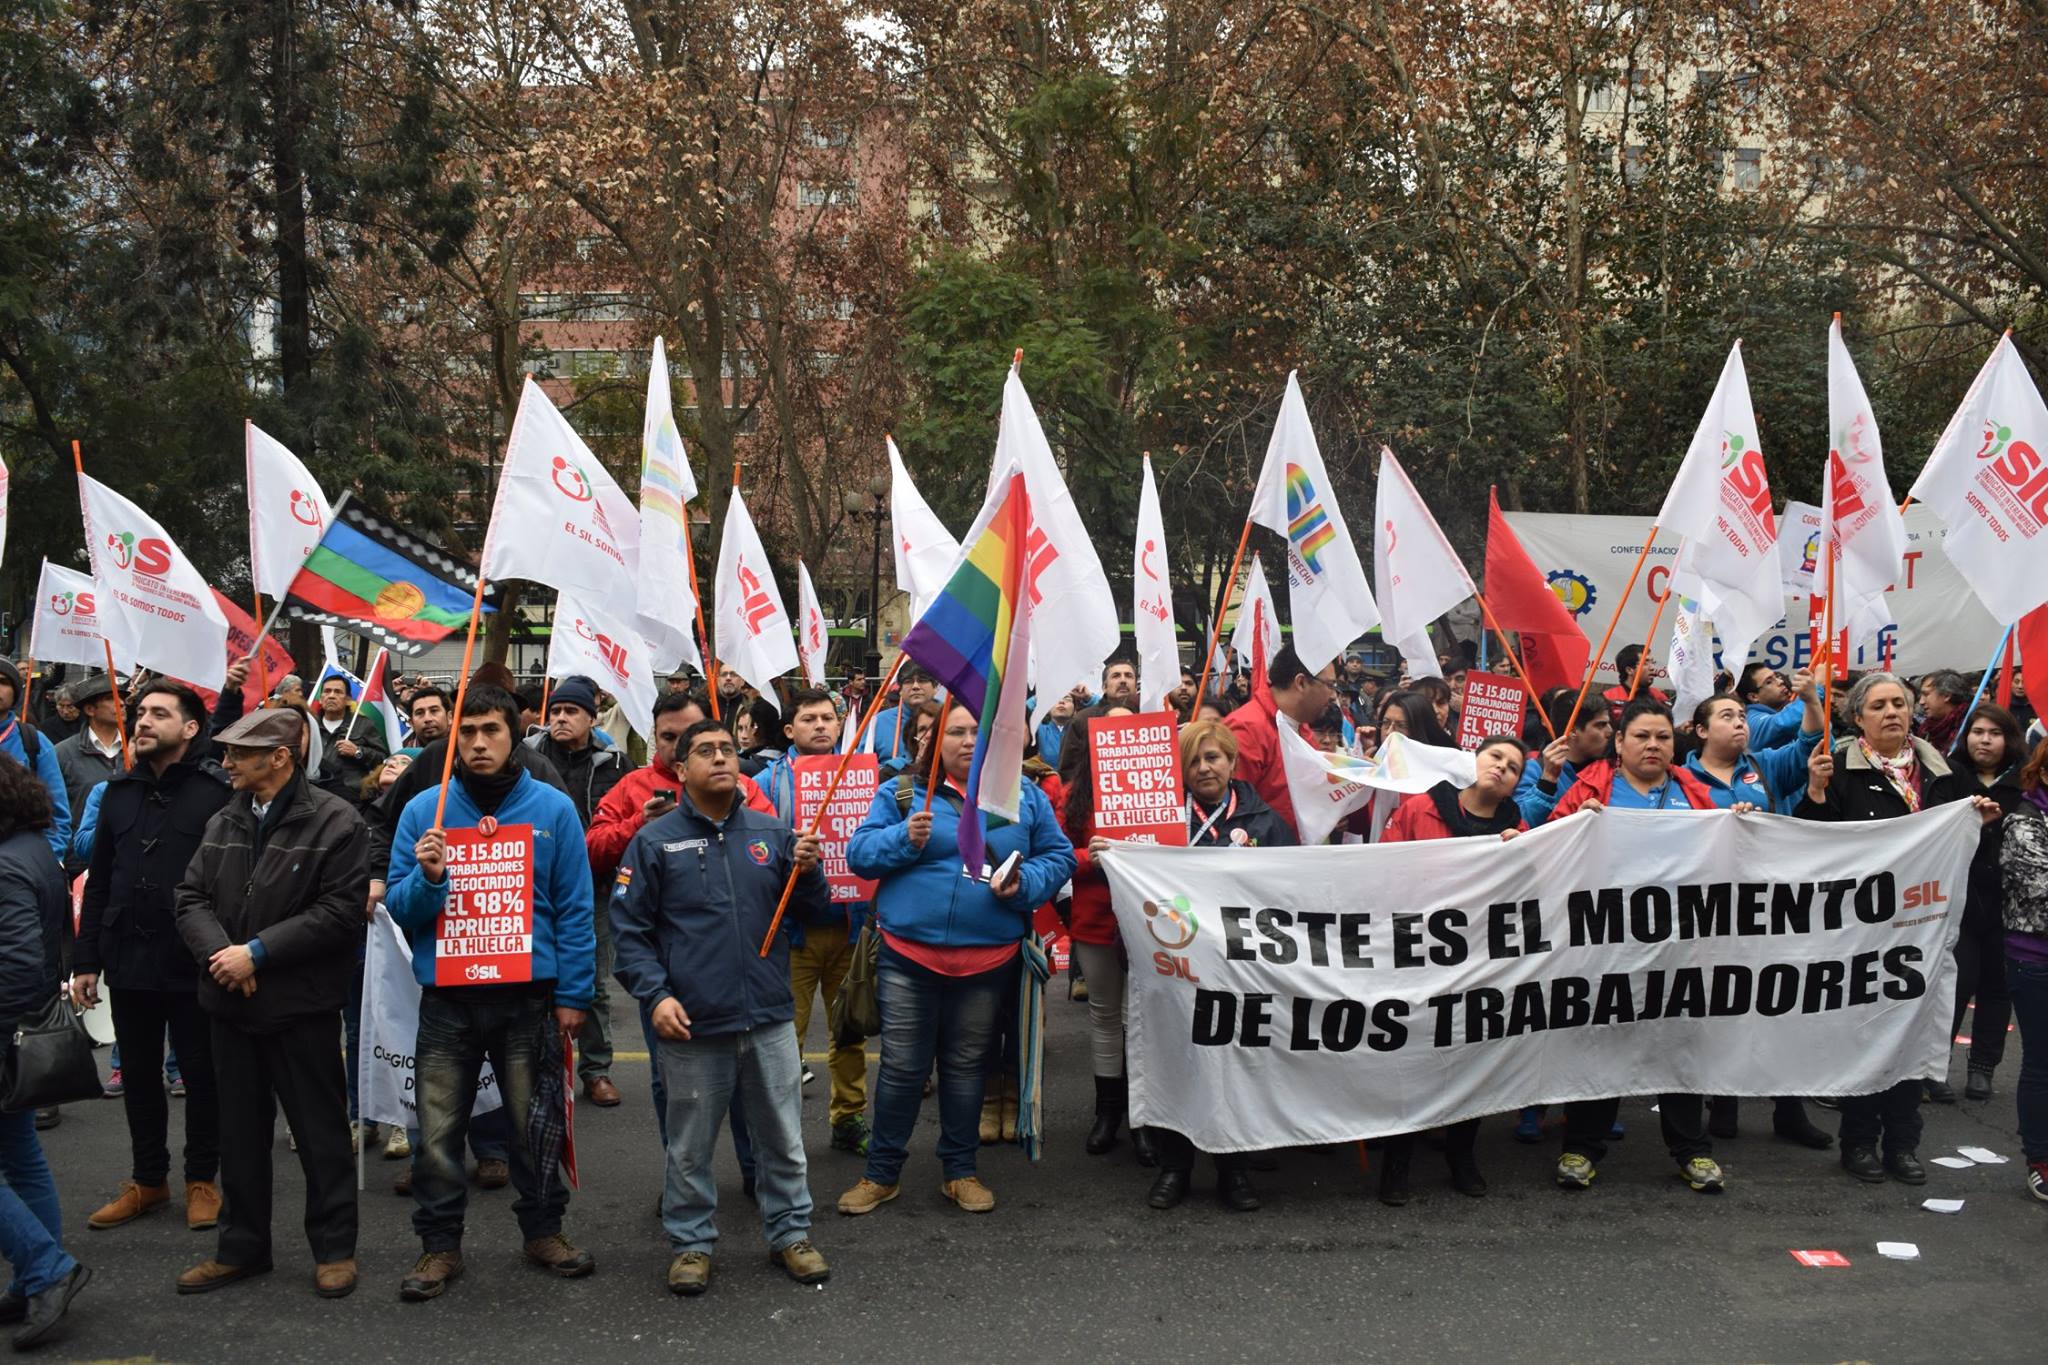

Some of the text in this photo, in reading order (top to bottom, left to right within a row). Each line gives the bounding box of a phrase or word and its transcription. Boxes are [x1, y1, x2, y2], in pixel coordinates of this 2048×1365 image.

[1720, 481, 1743, 511] INDICATO
[1965, 491, 1990, 518] SOMOS
[1987, 514, 2010, 542] TODOS
[565, 521, 577, 536] EL
[578, 529, 593, 544] SIL
[1727, 529, 1749, 557] TODOS
[129, 597, 155, 613] SOMOS
[158, 607, 186, 623] TODOS
[1140, 599, 1149, 609] EL
[1469, 682, 1522, 702] DE 15.800
[1465, 704, 1519, 723] NEGOCIANDO
[1467, 695, 1520, 712] TRABAJADORES
[1096, 725, 1171, 746] DE 15.800
[1463, 715, 1517, 737] EL 98%
[1096, 743, 1171, 758] TRABAJADORES
[1098, 754, 1173, 772] NEGOCIANDO
[801, 771, 822, 788] DE
[1099, 768, 1175, 793] EL 98%
[800, 787, 875, 801] TRABJADORES
[1101, 790, 1178, 811] APRUEBA
[801, 801, 873, 817] NEOCIAND
[1102, 811, 1120, 826] LA
[1123, 808, 1179, 825] HUELGA
[832, 816, 867, 838] 98
[446, 840, 526, 862] DE 15.800
[838, 885, 861, 898] SIL
[1903, 880, 1947, 910] SIL
[444, 890, 525, 917] EL 98%
[444, 915, 525, 938] APRUEBA
[1220, 871, 1896, 969] ESTE ES EL MOMENTO
[444, 936, 524, 955] LA HUELGA
[479, 965, 502, 979] SIL
[1152, 951, 1200, 983] SIL
[1192, 945, 1926, 1052] DE LOS TRABAJADORES
